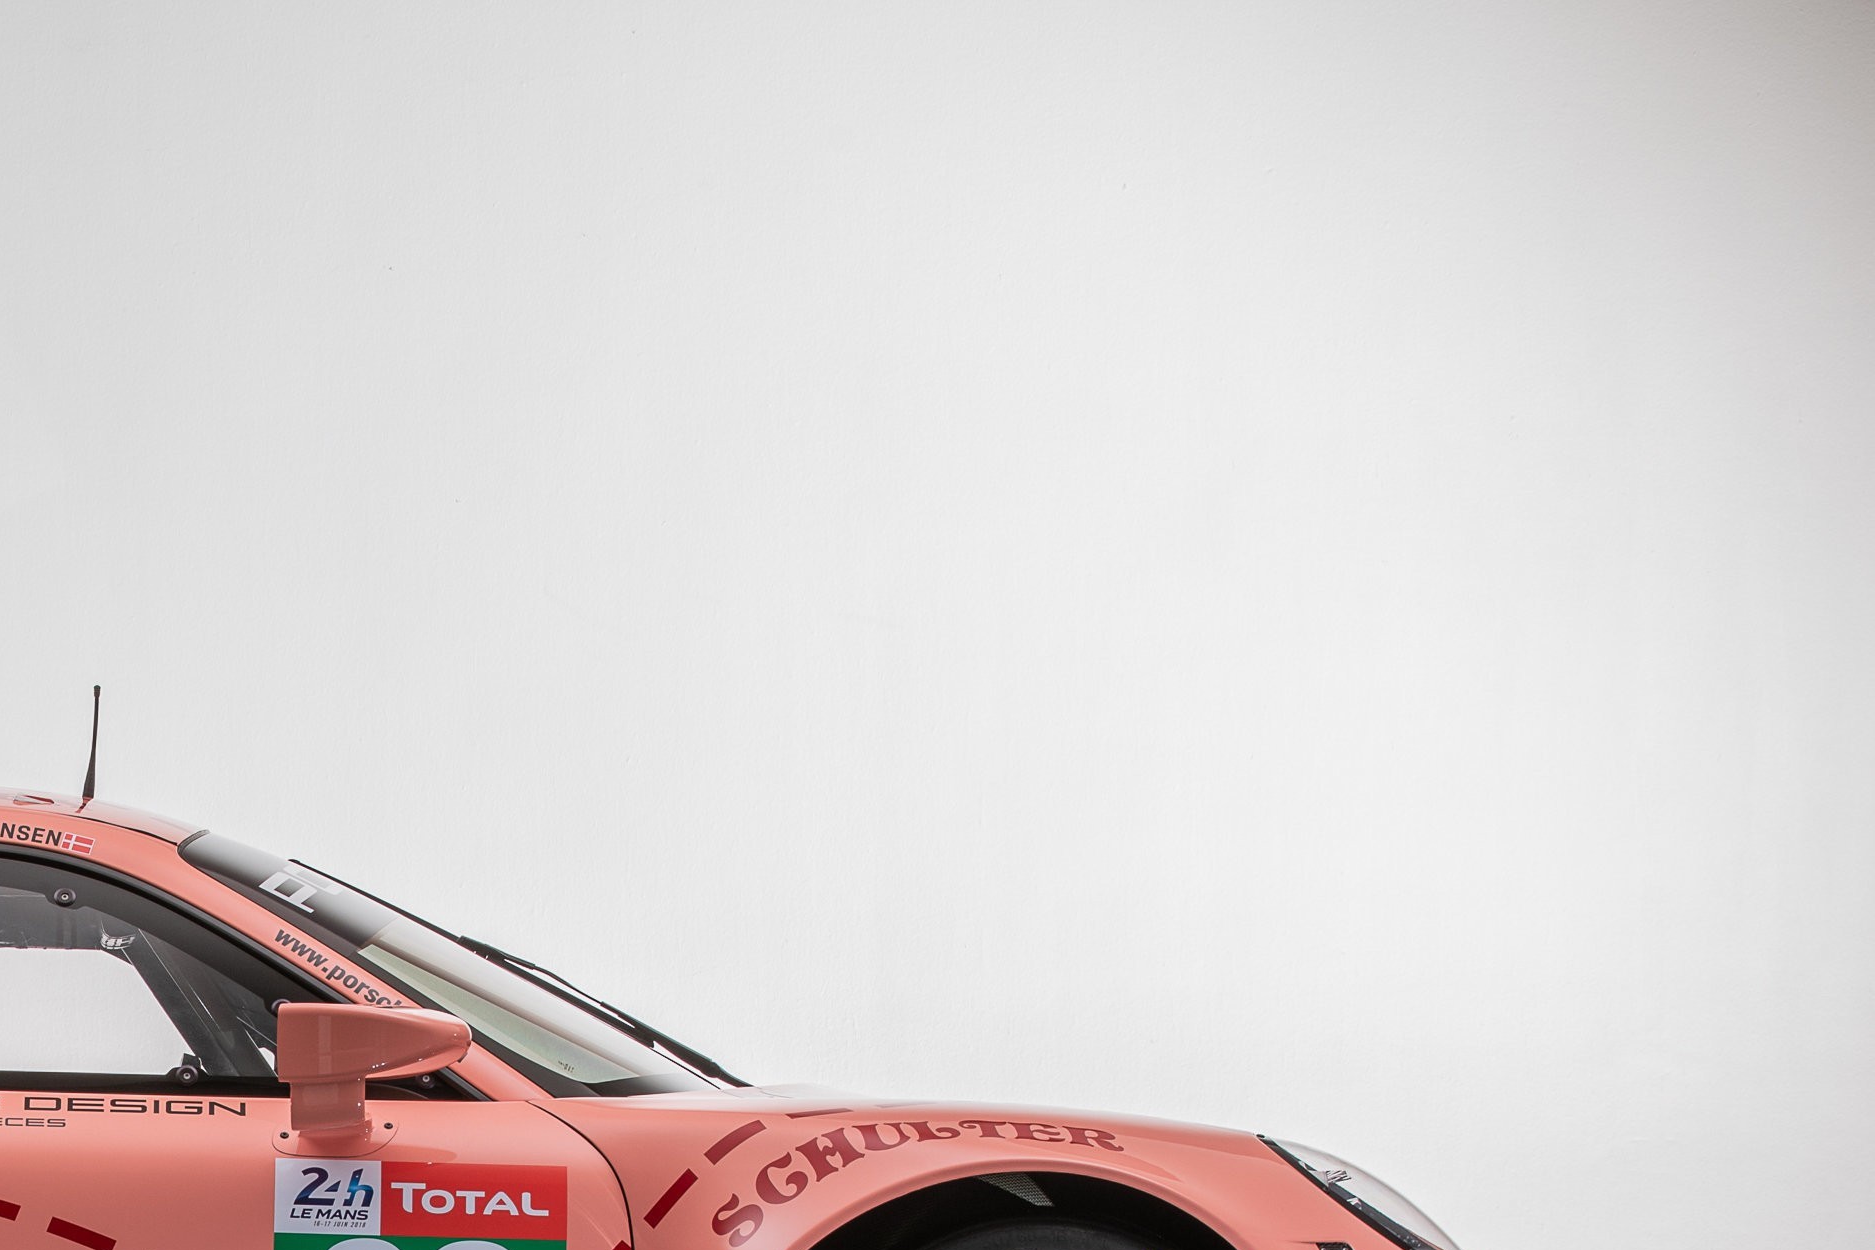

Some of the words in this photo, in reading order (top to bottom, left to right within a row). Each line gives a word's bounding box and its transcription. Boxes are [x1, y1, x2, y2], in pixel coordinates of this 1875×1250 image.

[274, 928, 402, 1007] www.porsc
[23, 1095, 247, 1117] DESIGN
[711, 1119, 1126, 1249] SCHULTER
[289, 1207, 314, 1219] LE
[315, 1208, 369, 1221] MANS
